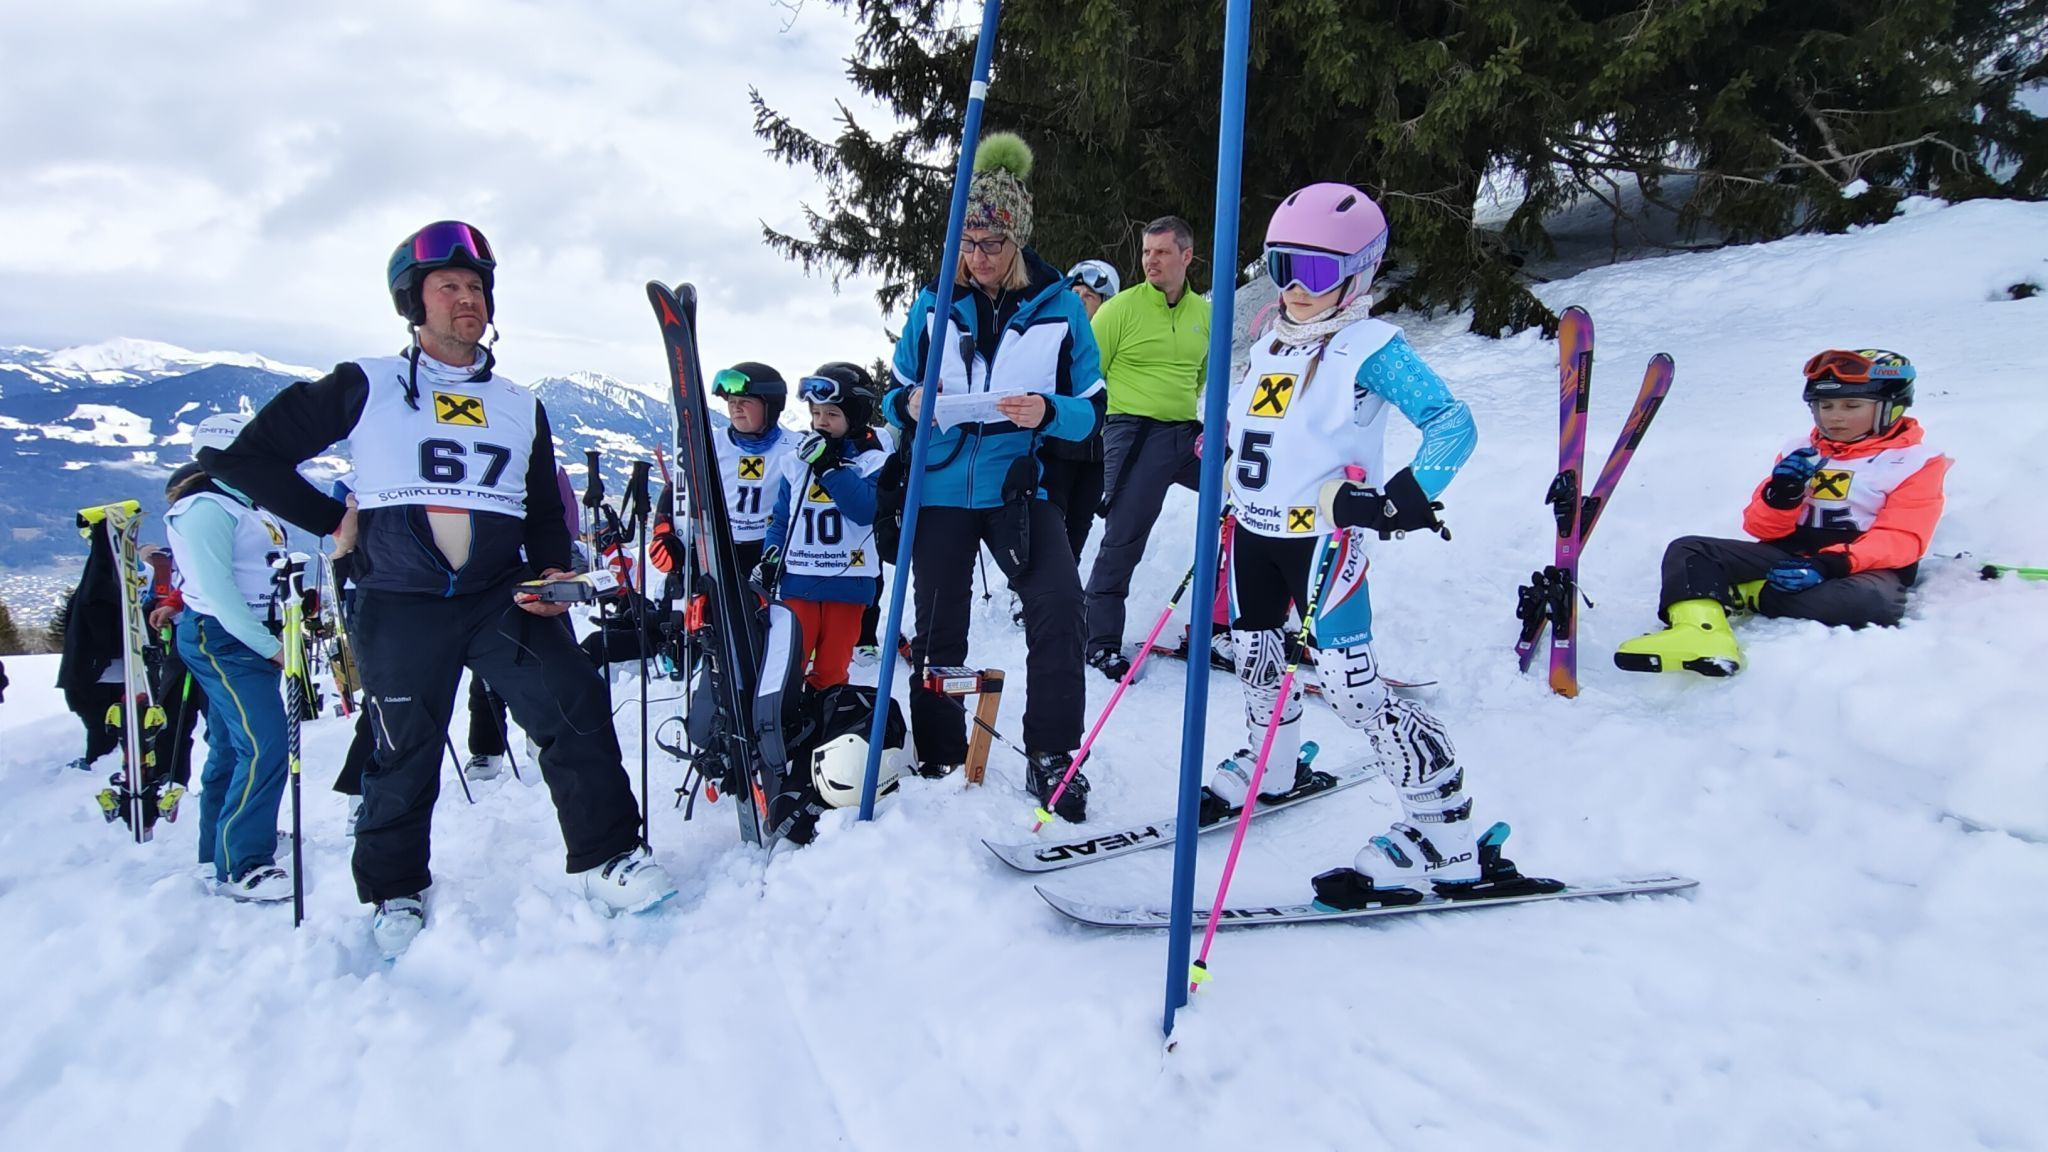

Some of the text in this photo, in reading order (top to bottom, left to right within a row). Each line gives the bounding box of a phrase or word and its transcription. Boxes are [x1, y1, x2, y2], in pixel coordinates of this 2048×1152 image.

[200, 427, 235, 435] SMITH
[418, 437, 512, 488] 67
[1236, 428, 1275, 492] 5
[736, 485, 763, 514] 11
[802, 506, 844, 546] 10
[789, 549, 848, 560] Raiffeisenbank
[814, 560, 848, 568] Satteins
[1424, 852, 1473, 873] HEAD
